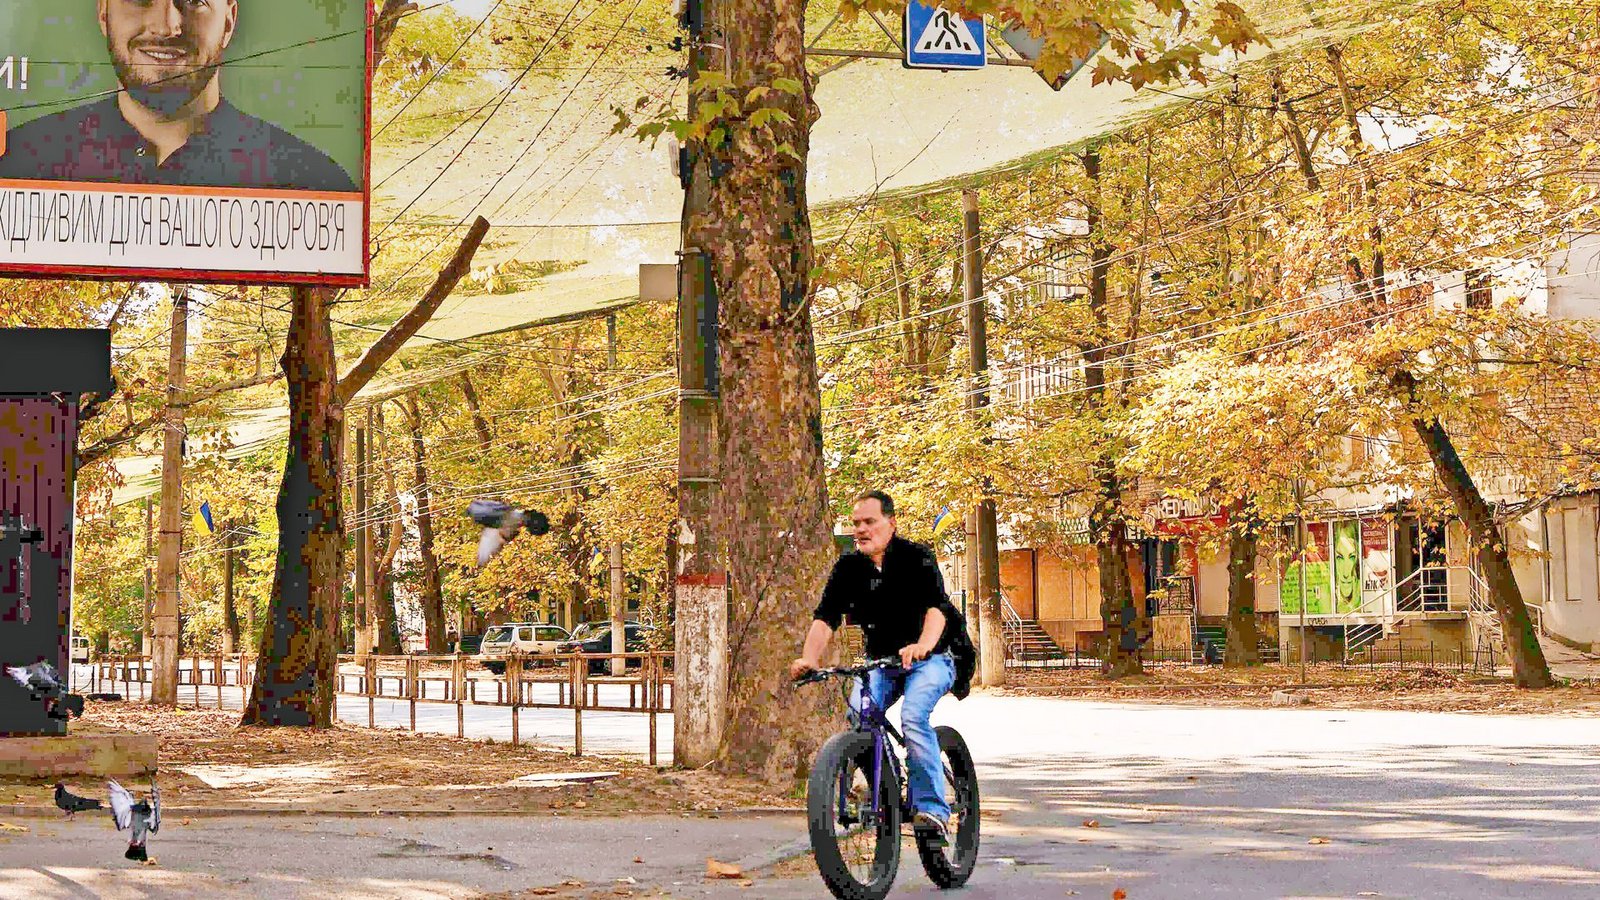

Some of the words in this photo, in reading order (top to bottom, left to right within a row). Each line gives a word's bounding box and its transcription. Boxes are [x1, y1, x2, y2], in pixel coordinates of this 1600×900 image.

[108, 195, 152, 256] ДЛЯ
[159, 196, 244, 248] ВАШОГО
[249, 200, 345, 260] ЗДОРОВ'Я
